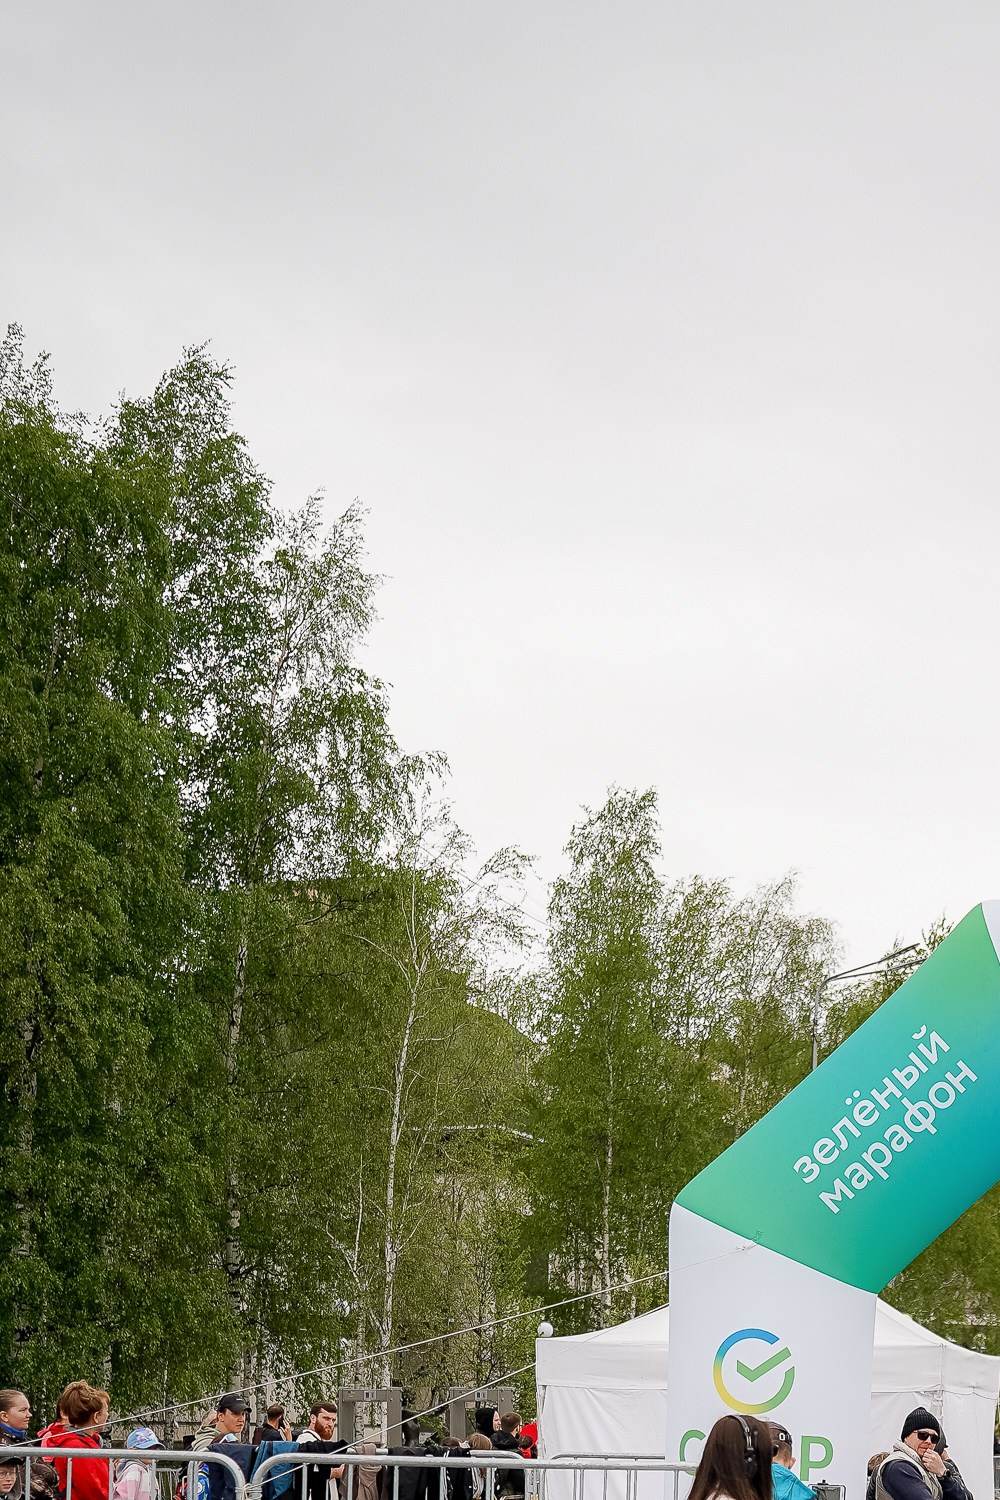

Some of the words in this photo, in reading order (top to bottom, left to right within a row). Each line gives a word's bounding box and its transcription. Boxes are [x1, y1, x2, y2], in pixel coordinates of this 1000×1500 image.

[793, 1024, 951, 1184] зелёный
[818, 1059, 979, 1214] марафон
[679, 1429, 834, 1482] СР
